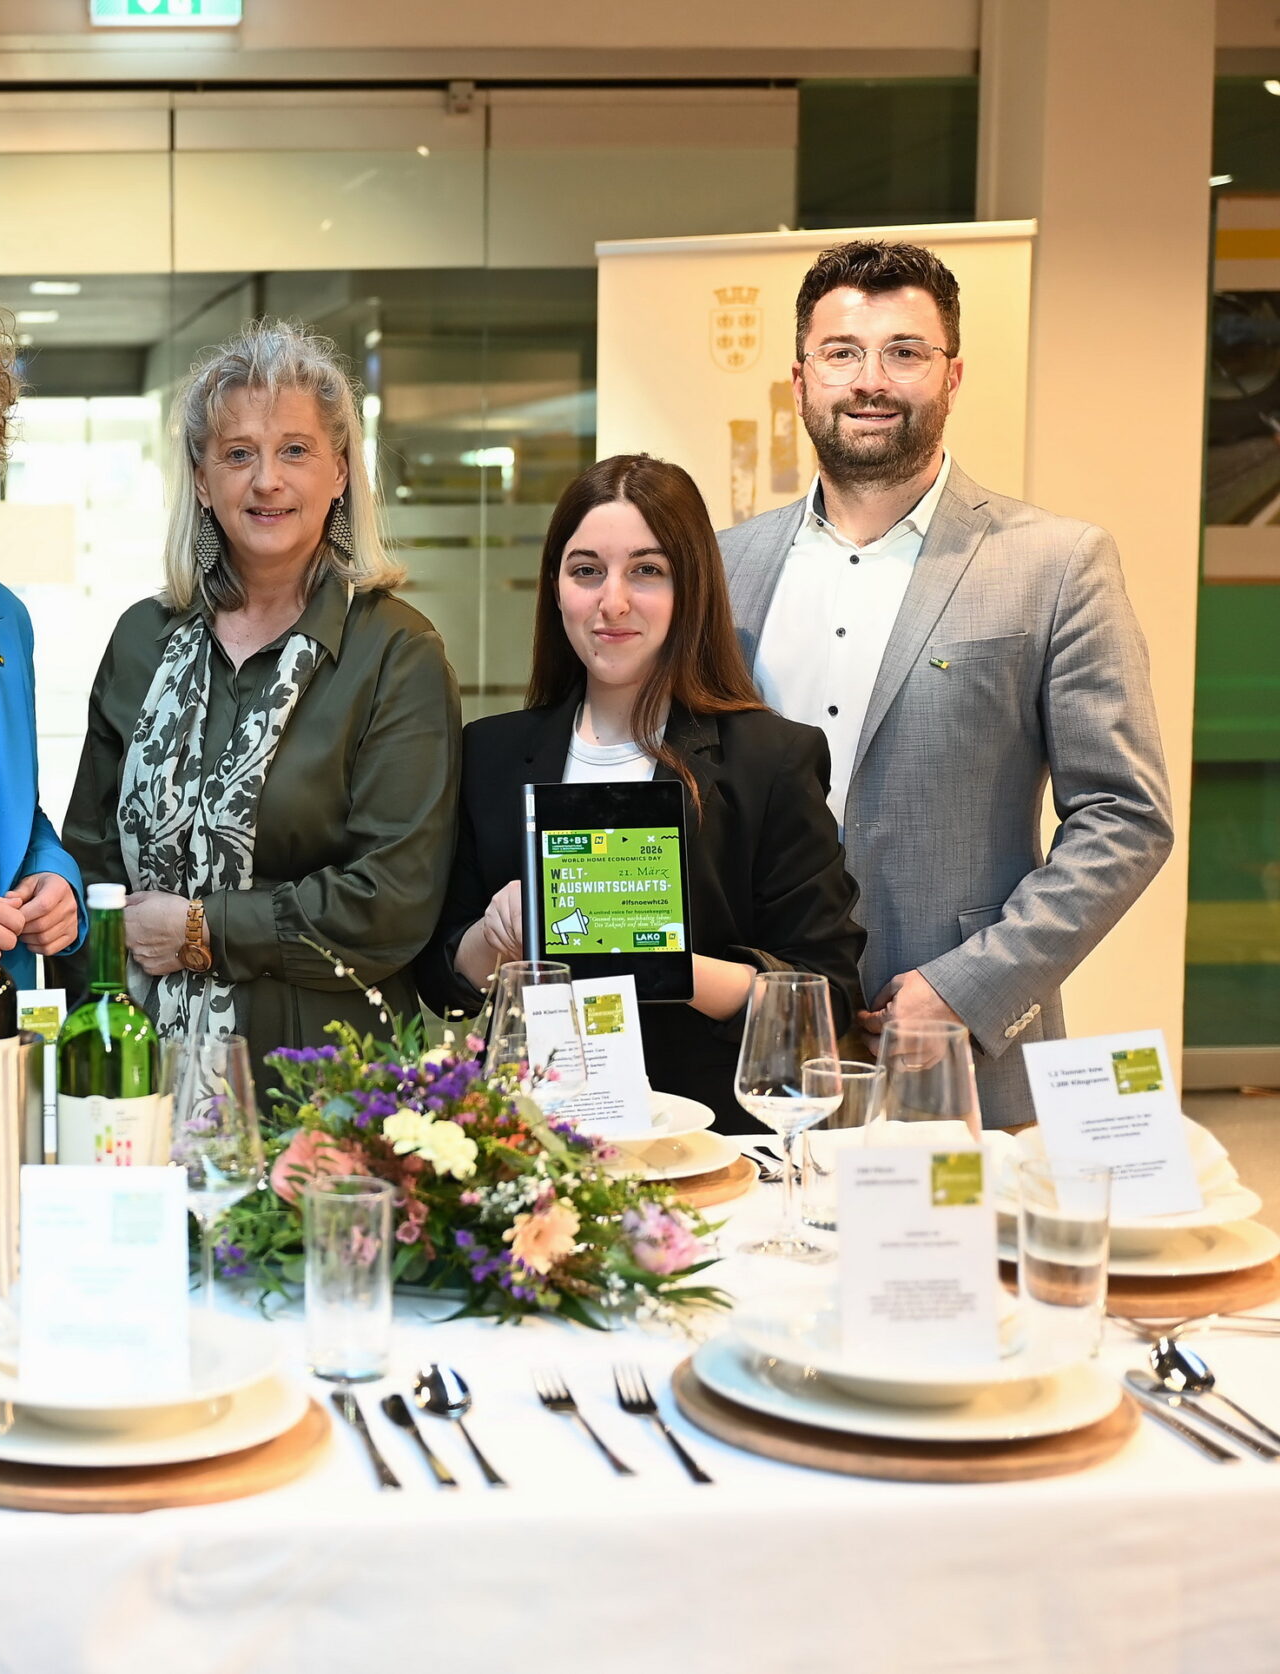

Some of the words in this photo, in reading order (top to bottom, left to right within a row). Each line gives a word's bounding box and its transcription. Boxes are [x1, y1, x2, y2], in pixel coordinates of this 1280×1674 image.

[551, 836, 588, 845] LFS+BS
[640, 845, 663, 855] 2026
[551, 867, 588, 880] WELT-
[618, 869, 633, 877] 21.
[637, 866, 670, 879] März
[551, 880, 672, 894] HAUSWIRTSCHAFTS-
[551, 895, 575, 908] TAG
[621, 898, 669, 906] #lfsnoewht26
[635, 932, 661, 941] LAKO
